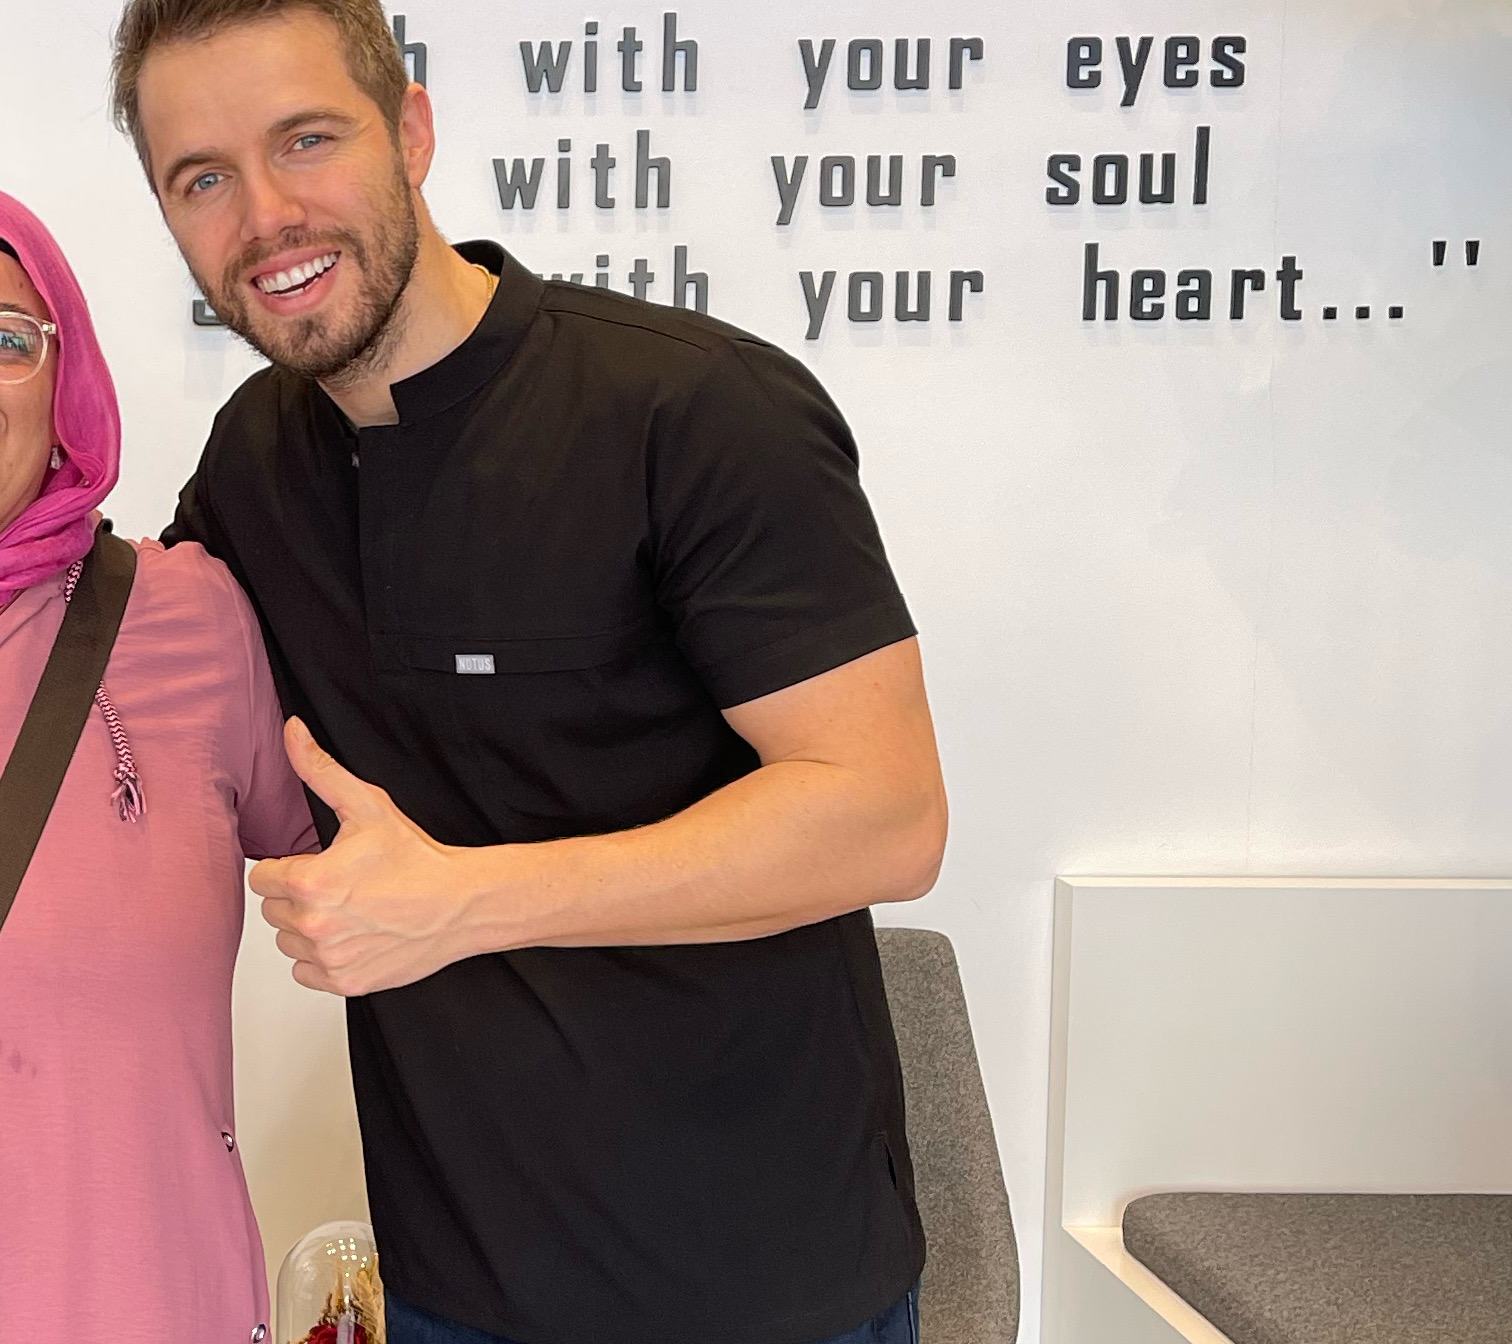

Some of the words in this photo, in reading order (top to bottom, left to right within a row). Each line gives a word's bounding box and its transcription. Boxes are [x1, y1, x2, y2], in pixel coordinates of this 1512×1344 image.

[519, 12, 698, 93] with
[798, 38, 984, 109] your
[1066, 36, 1247, 107] eyes
[492, 130, 671, 209] with
[771, 155, 956, 225] your
[1045, 126, 1211, 205] soul
[533, 245, 708, 315] ith
[798, 271, 984, 339] your
[458, 657, 492, 671] NOTUS
